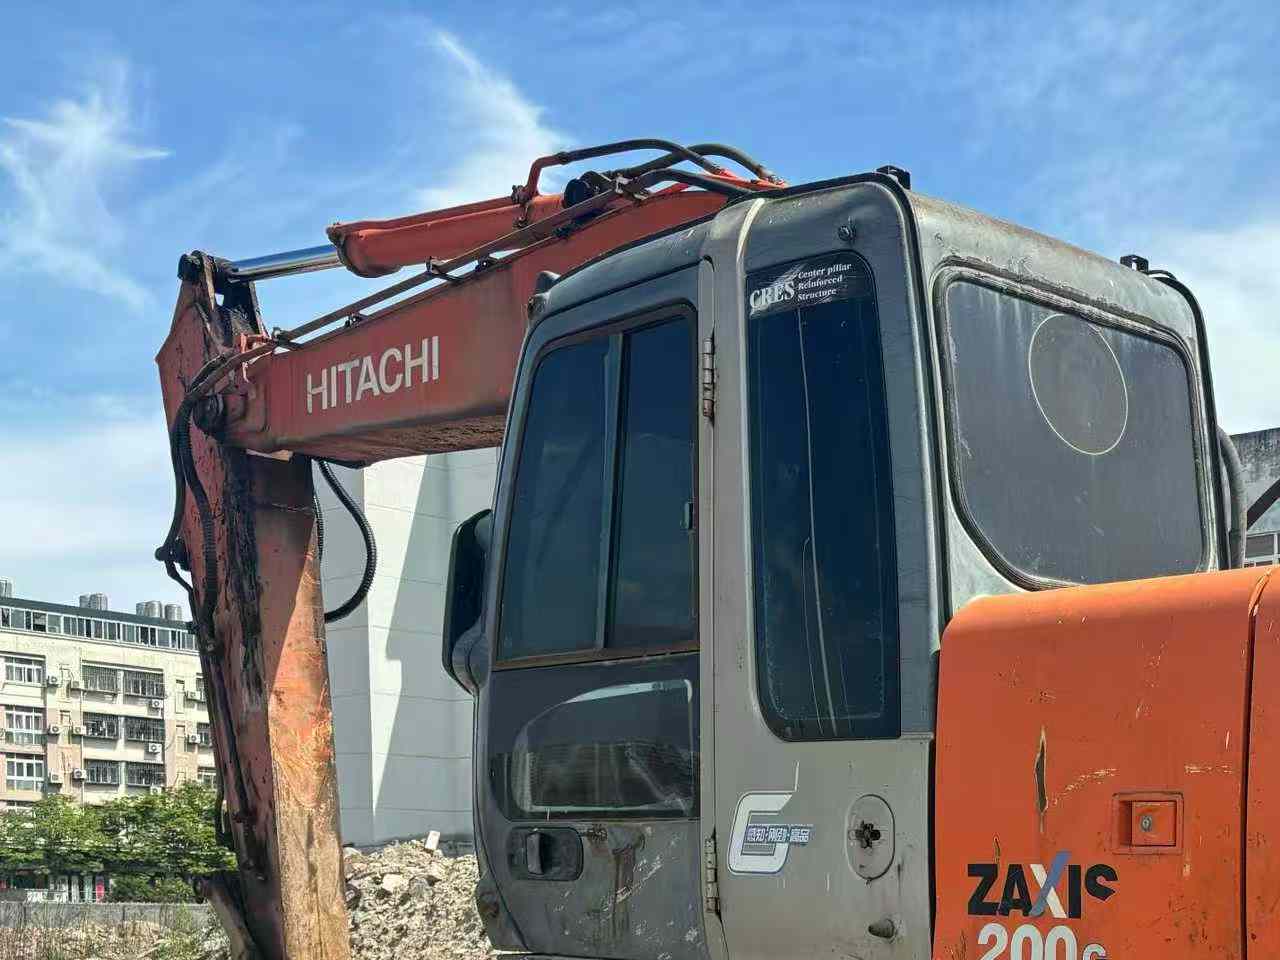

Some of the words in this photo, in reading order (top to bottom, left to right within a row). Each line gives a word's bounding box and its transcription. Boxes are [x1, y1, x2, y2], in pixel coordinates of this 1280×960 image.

[798, 268, 825, 280] Center
[827, 263, 852, 274] pillar
[798, 275, 843, 291] Reinforced
[750, 281, 796, 310] CRES
[797, 288, 837, 302] Structure
[306, 335, 440, 414] HITACHI
